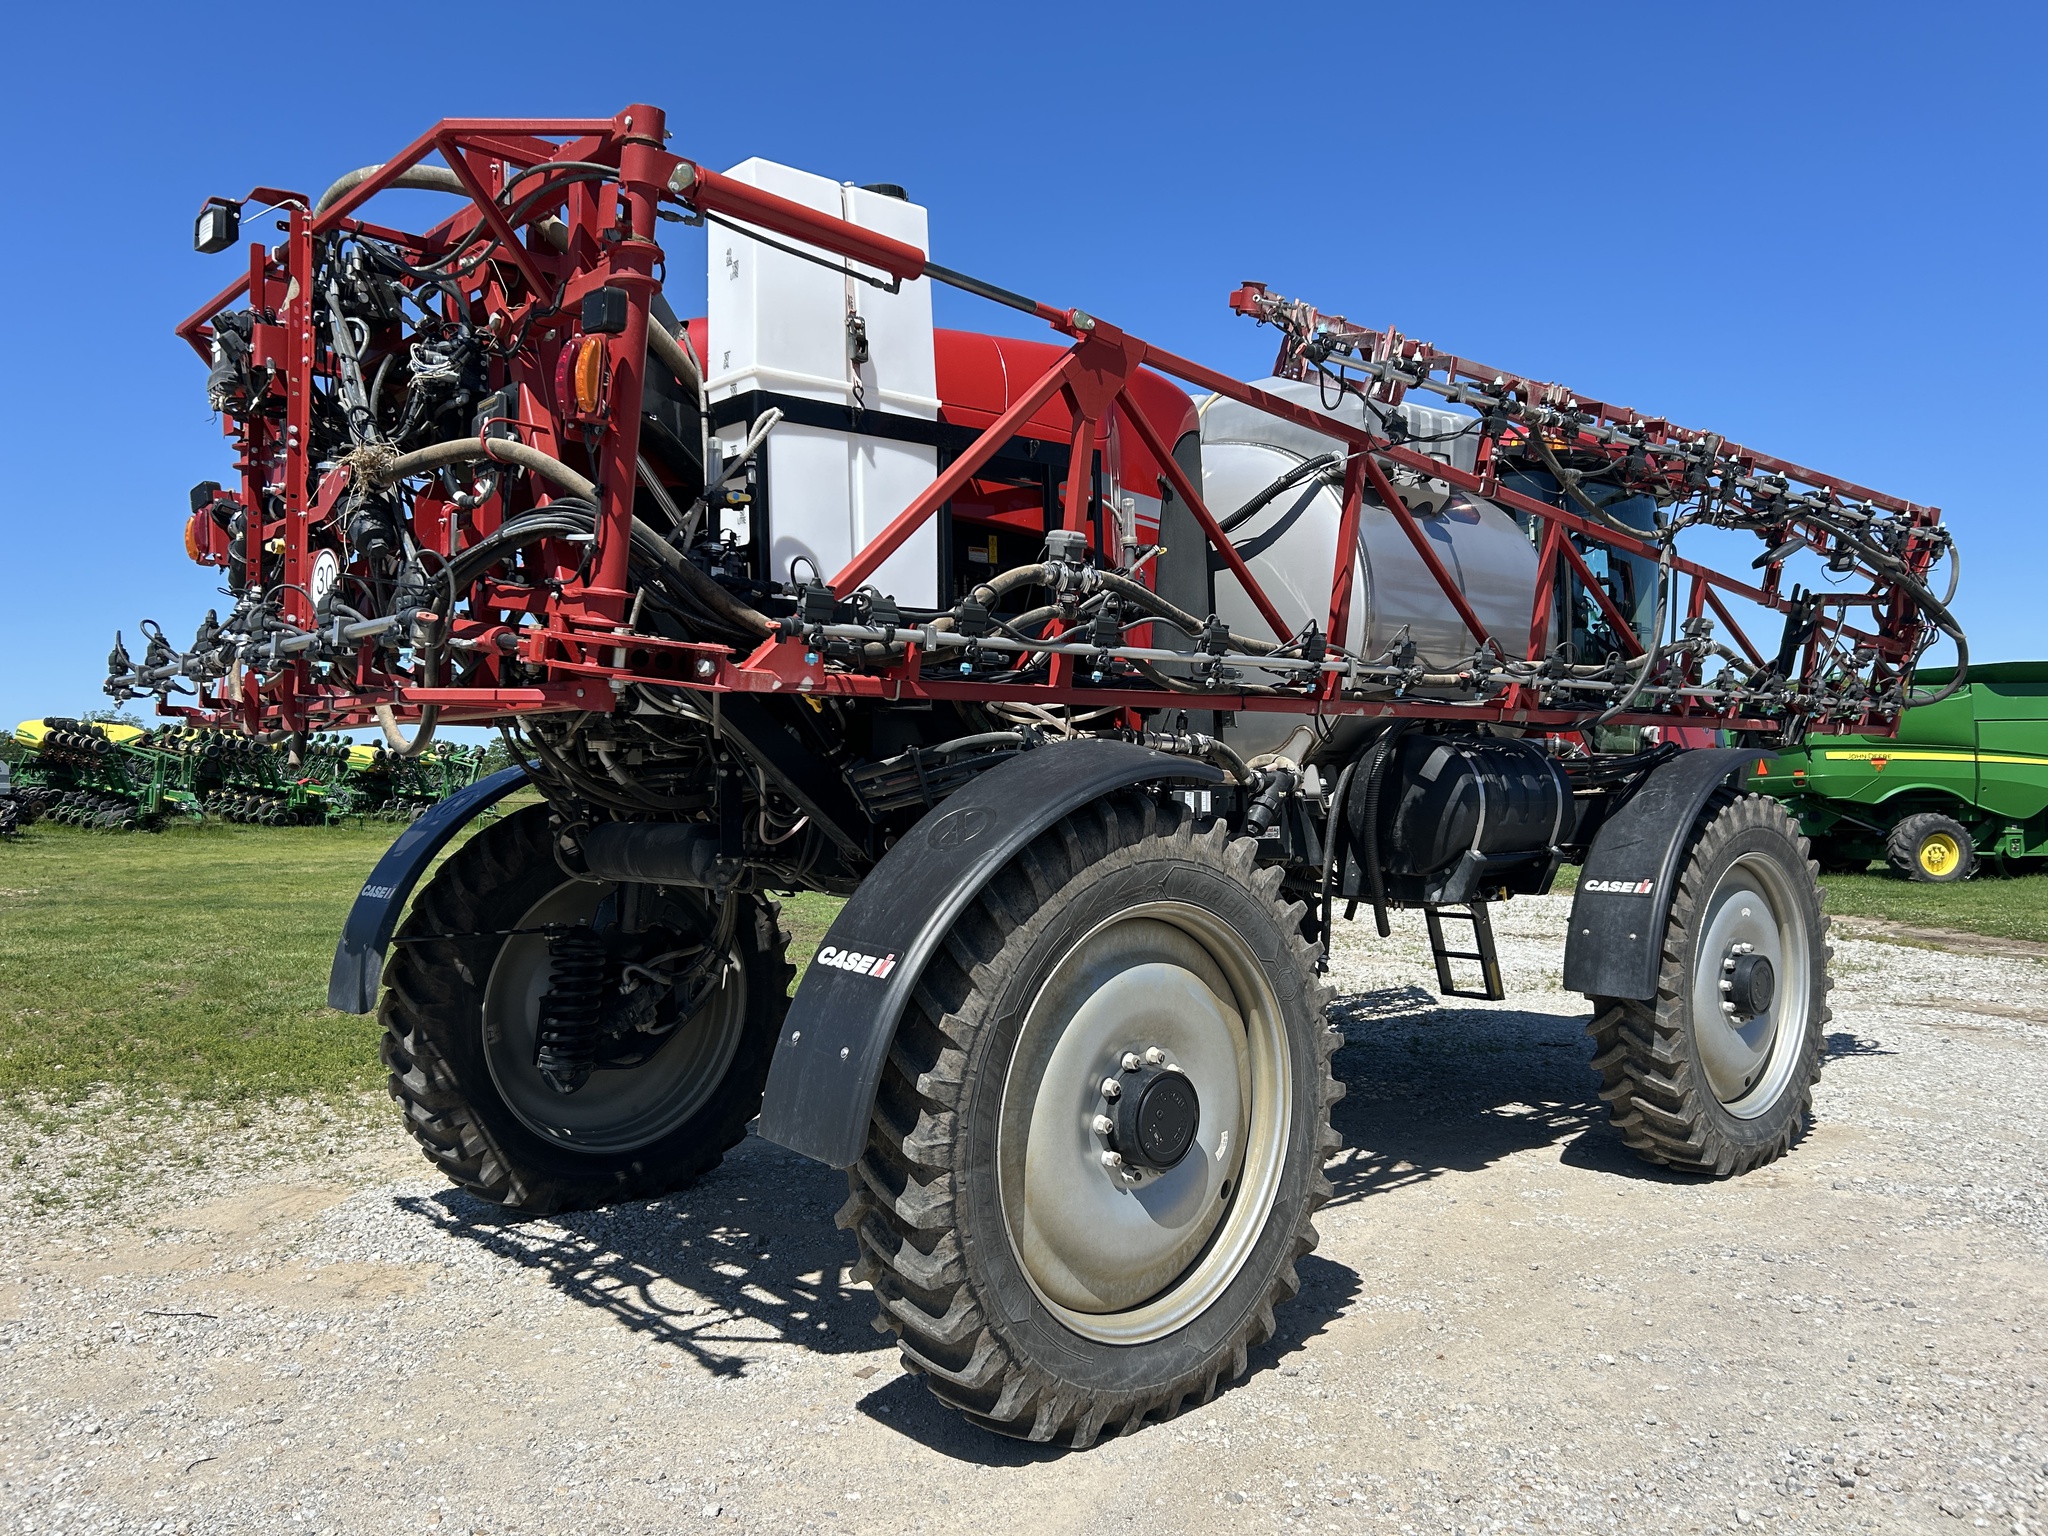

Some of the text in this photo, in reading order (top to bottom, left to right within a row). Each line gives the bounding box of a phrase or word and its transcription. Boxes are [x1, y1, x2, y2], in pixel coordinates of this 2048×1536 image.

[317, 564, 333, 595] 30
[361, 885, 388, 898] CASE
[1584, 879, 1636, 893] CASE
[817, 946, 877, 974] CASE
